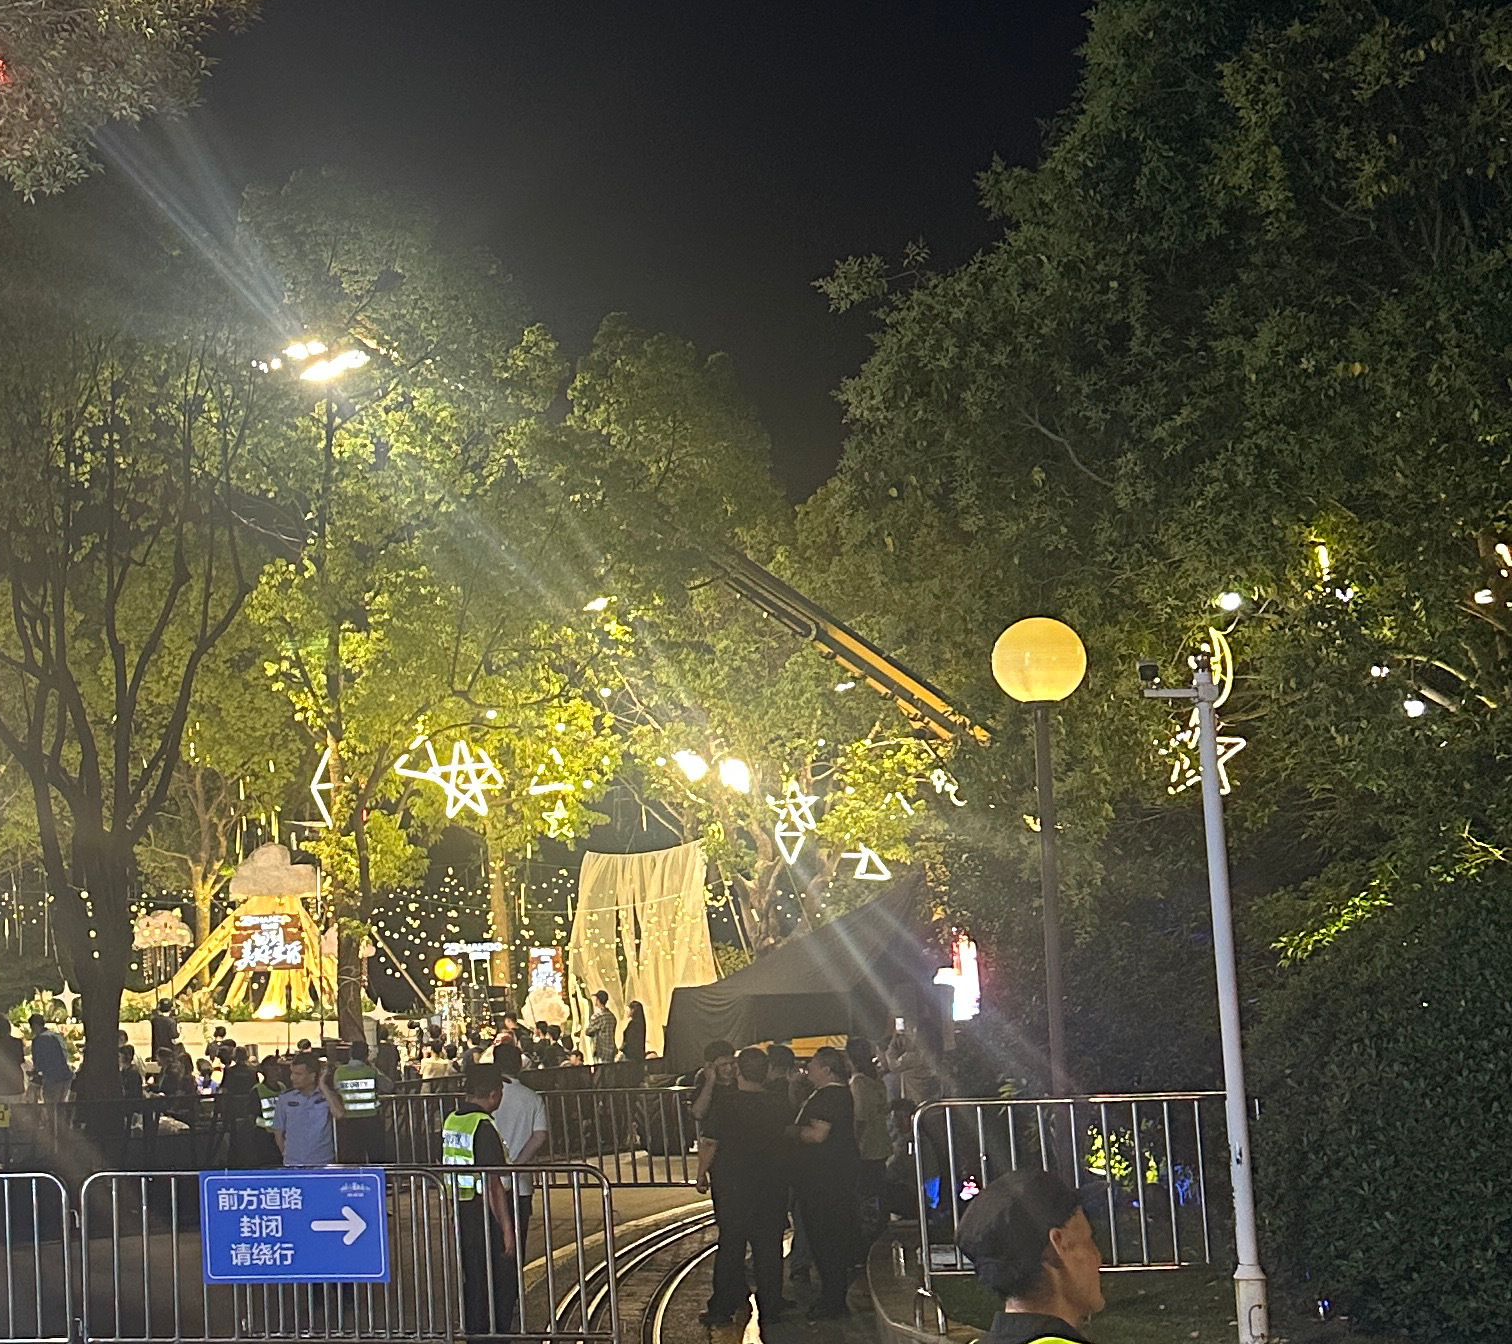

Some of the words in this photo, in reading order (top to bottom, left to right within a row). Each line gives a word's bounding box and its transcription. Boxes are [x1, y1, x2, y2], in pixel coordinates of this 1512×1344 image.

[217, 1187, 303, 1211] 前方道路
[239, 1215, 282, 1238] 封闭
[230, 1243, 295, 1266] 请绕行
